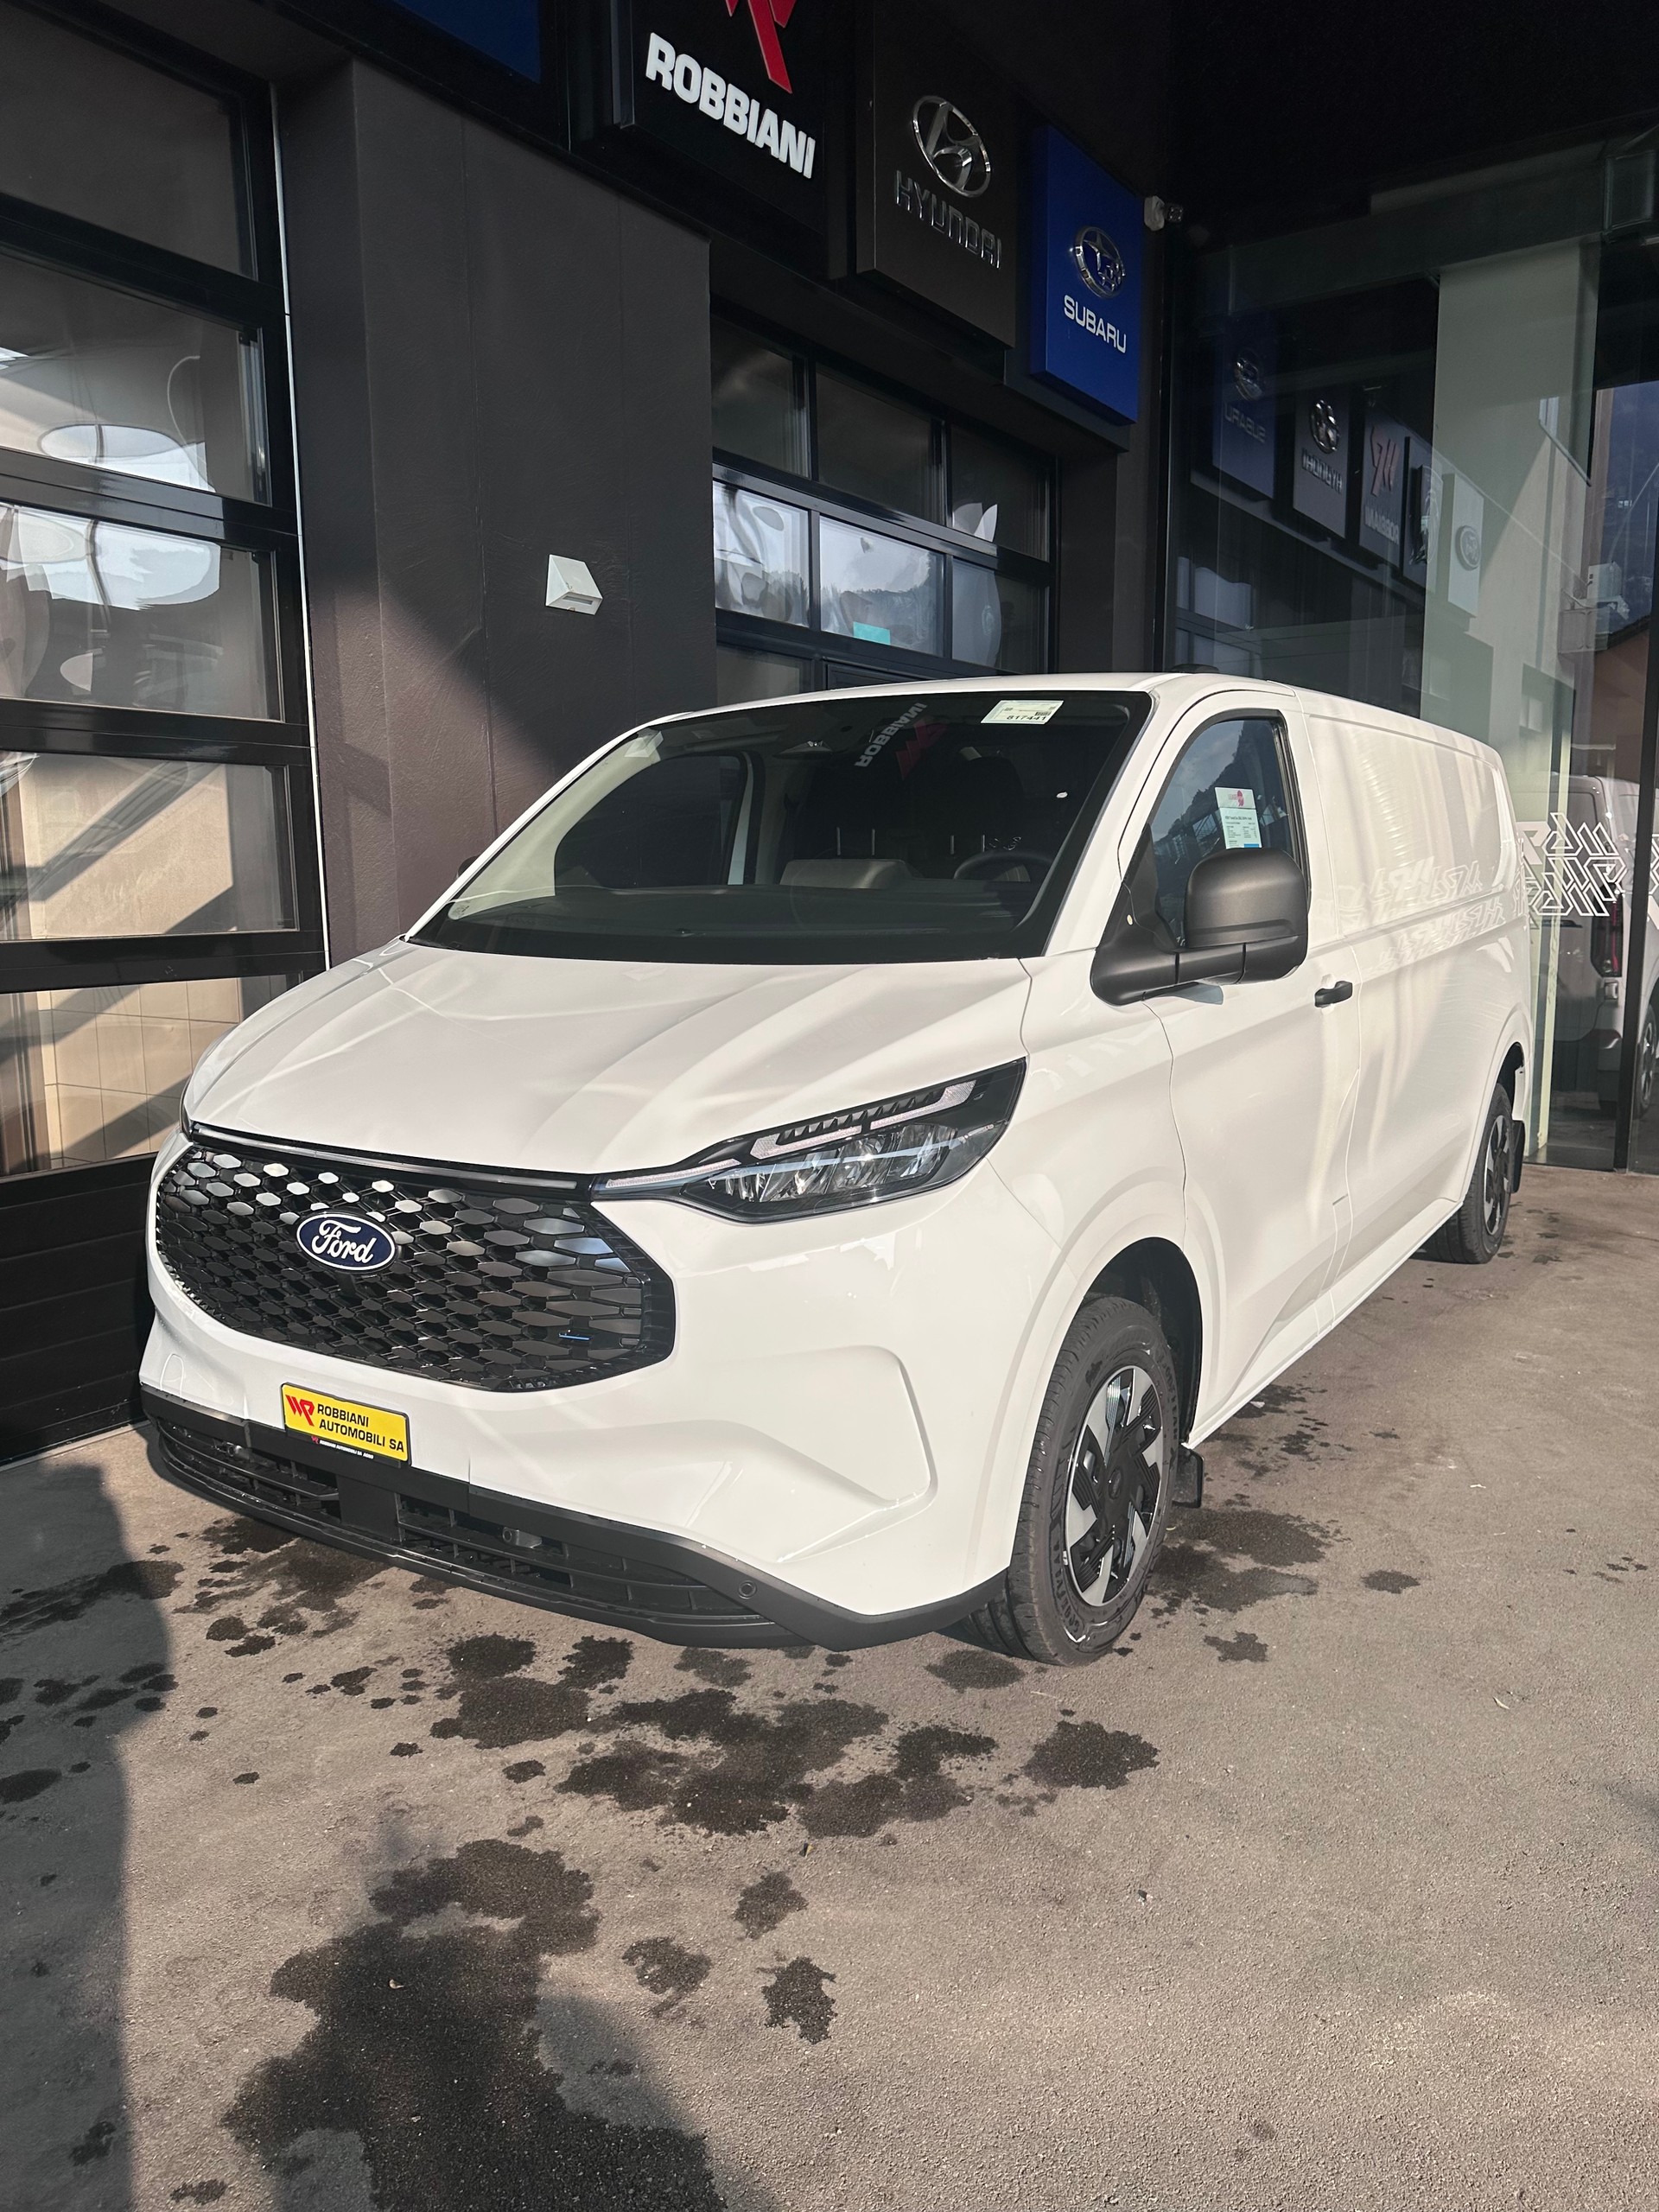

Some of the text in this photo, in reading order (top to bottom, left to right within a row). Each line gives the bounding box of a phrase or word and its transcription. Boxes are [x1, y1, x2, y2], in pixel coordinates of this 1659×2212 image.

[645, 32, 817, 180] ROBBIANI
[894, 169, 1002, 270] HYUNDAI
[1063, 294, 1128, 354] SUBARU
[311, 1219, 378, 1264] Ford
[317, 1403, 369, 1427] ROBBIANI
[319, 1419, 404, 1452] AUTOMOBILI SA
